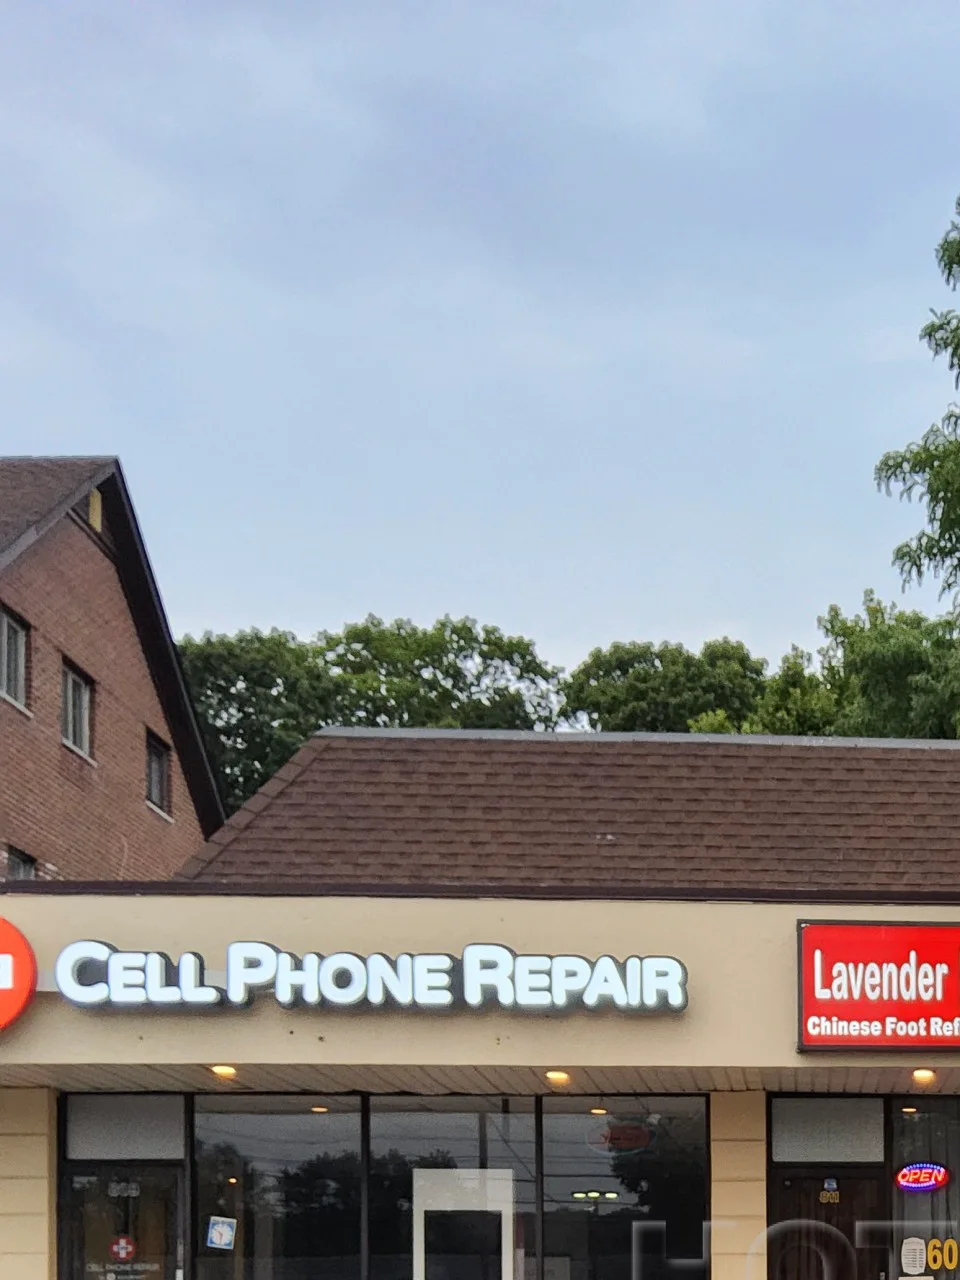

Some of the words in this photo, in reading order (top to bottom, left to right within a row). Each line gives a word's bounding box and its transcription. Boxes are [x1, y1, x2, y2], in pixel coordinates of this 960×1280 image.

[55, 939, 221, 1006] CELL
[226, 940, 454, 1007] PHONE
[462, 943, 689, 1010] REPAIR
[813, 948, 949, 1002] Lavender
[807, 1015, 882, 1037] Chinese
[885, 1016, 927, 1037] Foot
[897, 1168, 946, 1183] OPEN
[926, 1238, 959, 1270] 60
